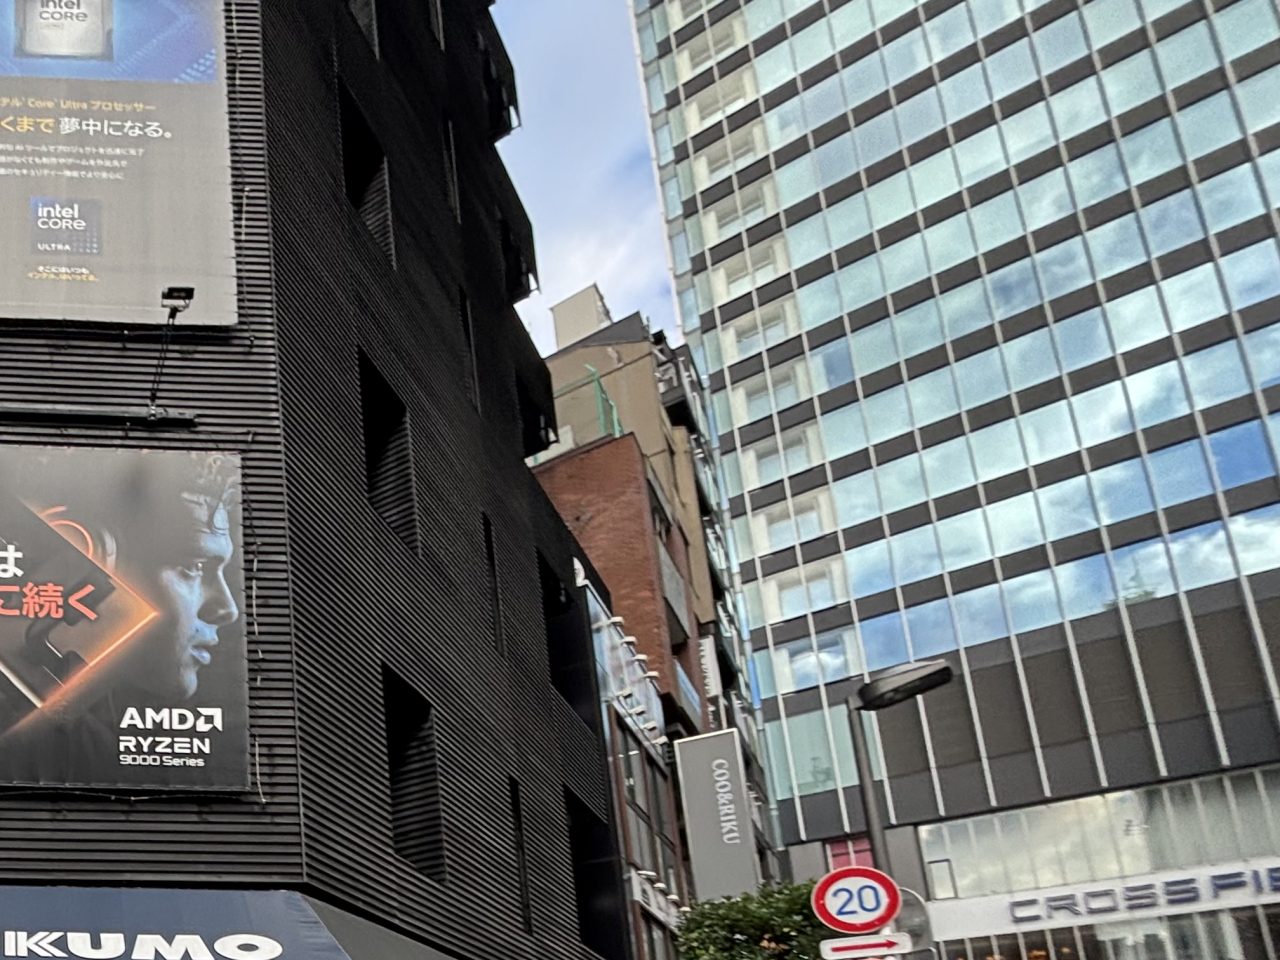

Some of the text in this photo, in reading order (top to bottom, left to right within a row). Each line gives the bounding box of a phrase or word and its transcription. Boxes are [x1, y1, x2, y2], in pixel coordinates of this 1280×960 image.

[59, 117, 173, 139] 夢中になる。
[37, 203, 79, 218] intel
[37, 242, 71, 251] ULTRA
[119, 706, 195, 730] AMD
[119, 736, 211, 754] RYZEN
[119, 755, 205, 767] 9000 Series
[711, 758, 741, 844] COO&RIKU
[831, 884, 882, 917] 20
[1008, 877, 1200, 923] CROSS
